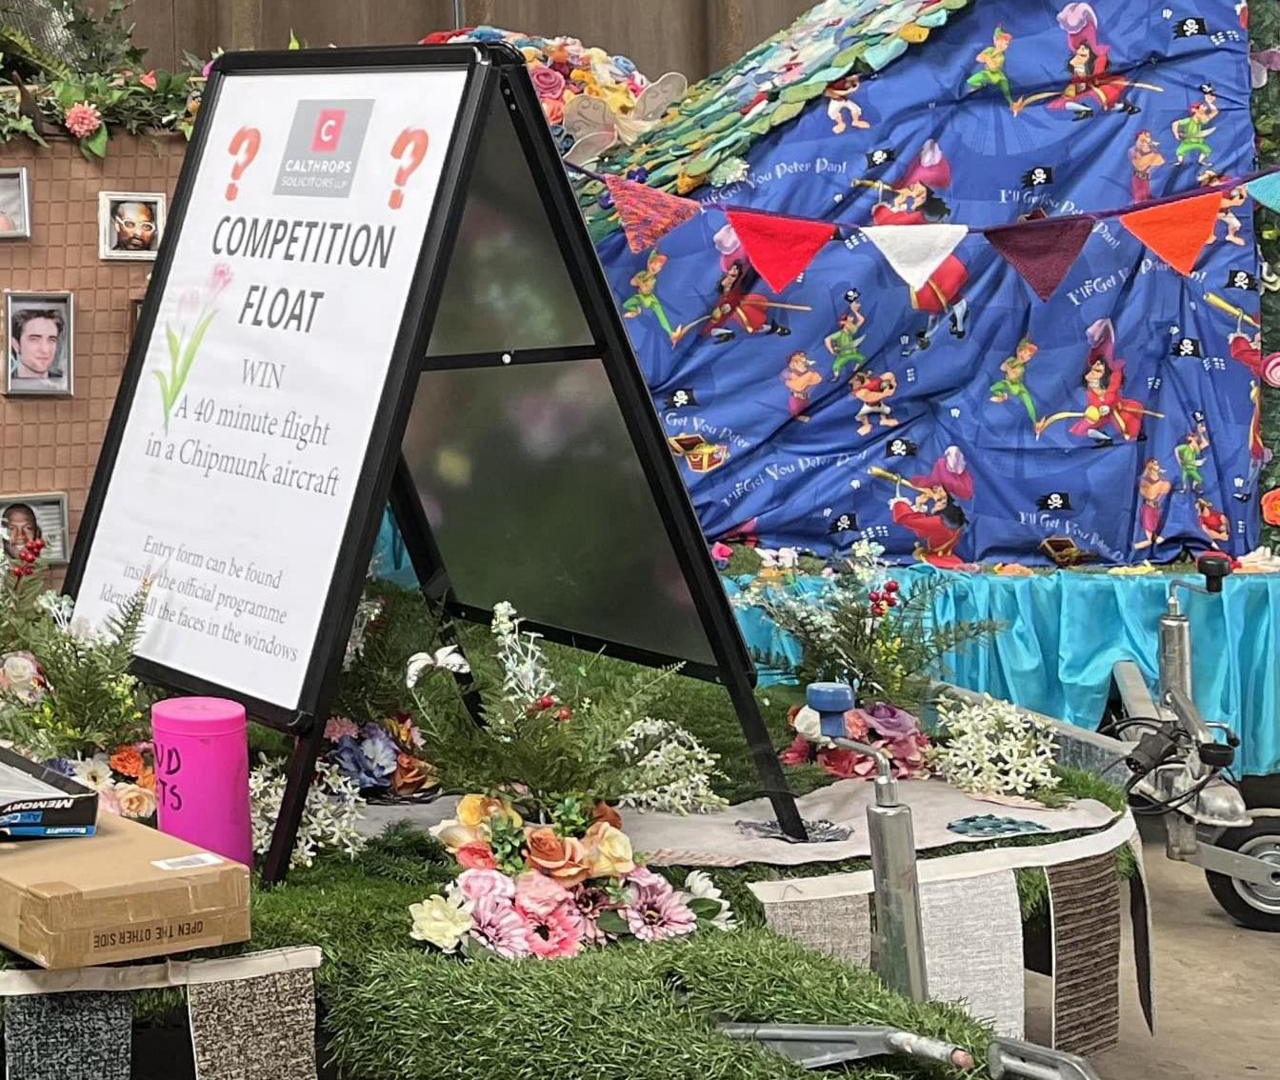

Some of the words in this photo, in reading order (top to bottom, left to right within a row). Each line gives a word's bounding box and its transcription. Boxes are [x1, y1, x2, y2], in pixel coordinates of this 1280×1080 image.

[284, 158, 353, 175] CALTHROPS
[775, 161, 812, 180] Peter
[280, 175, 333, 190] SOLICITORS
[999, 188, 1021, 204] I'll
[211, 214, 397, 269] COMPETITION
[237, 284, 326, 333] FLOAT
[242, 358, 287, 390] WIN
[173, 393, 189, 420] A
[193, 397, 216, 424] 40
[215, 403, 279, 436] minute
[280, 409, 332, 452] flight
[691, 417, 718, 434] You
[144, 431, 163, 459] in
[164, 442, 175, 461] a
[179, 438, 270, 482] Chipmunk
[271, 459, 340, 497] aircraft
[764, 463, 796, 482] You
[143, 534, 176, 560] Entry
[175, 543, 204, 568] form
[205, 556, 228, 574] can
[228, 557, 244, 579] be
[243, 561, 283, 590] found
[156, 569, 177, 591] the
[177, 576, 218, 603] official
[216, 591, 288, 625] programme
[157, 599, 177, 623] the
[176, 607, 206, 633] faces
[207, 617, 220, 637] in
[221, 621, 242, 645] the
[243, 630, 299, 662] windows
[158, 777, 183, 811] TS
[2, 798, 74, 814] MEMORY
[119, 928, 152, 945] OTHER
[155, 926, 174, 940] THE
[177, 920, 205, 935] OPEN
[93, 930, 116, 949] SIDE
